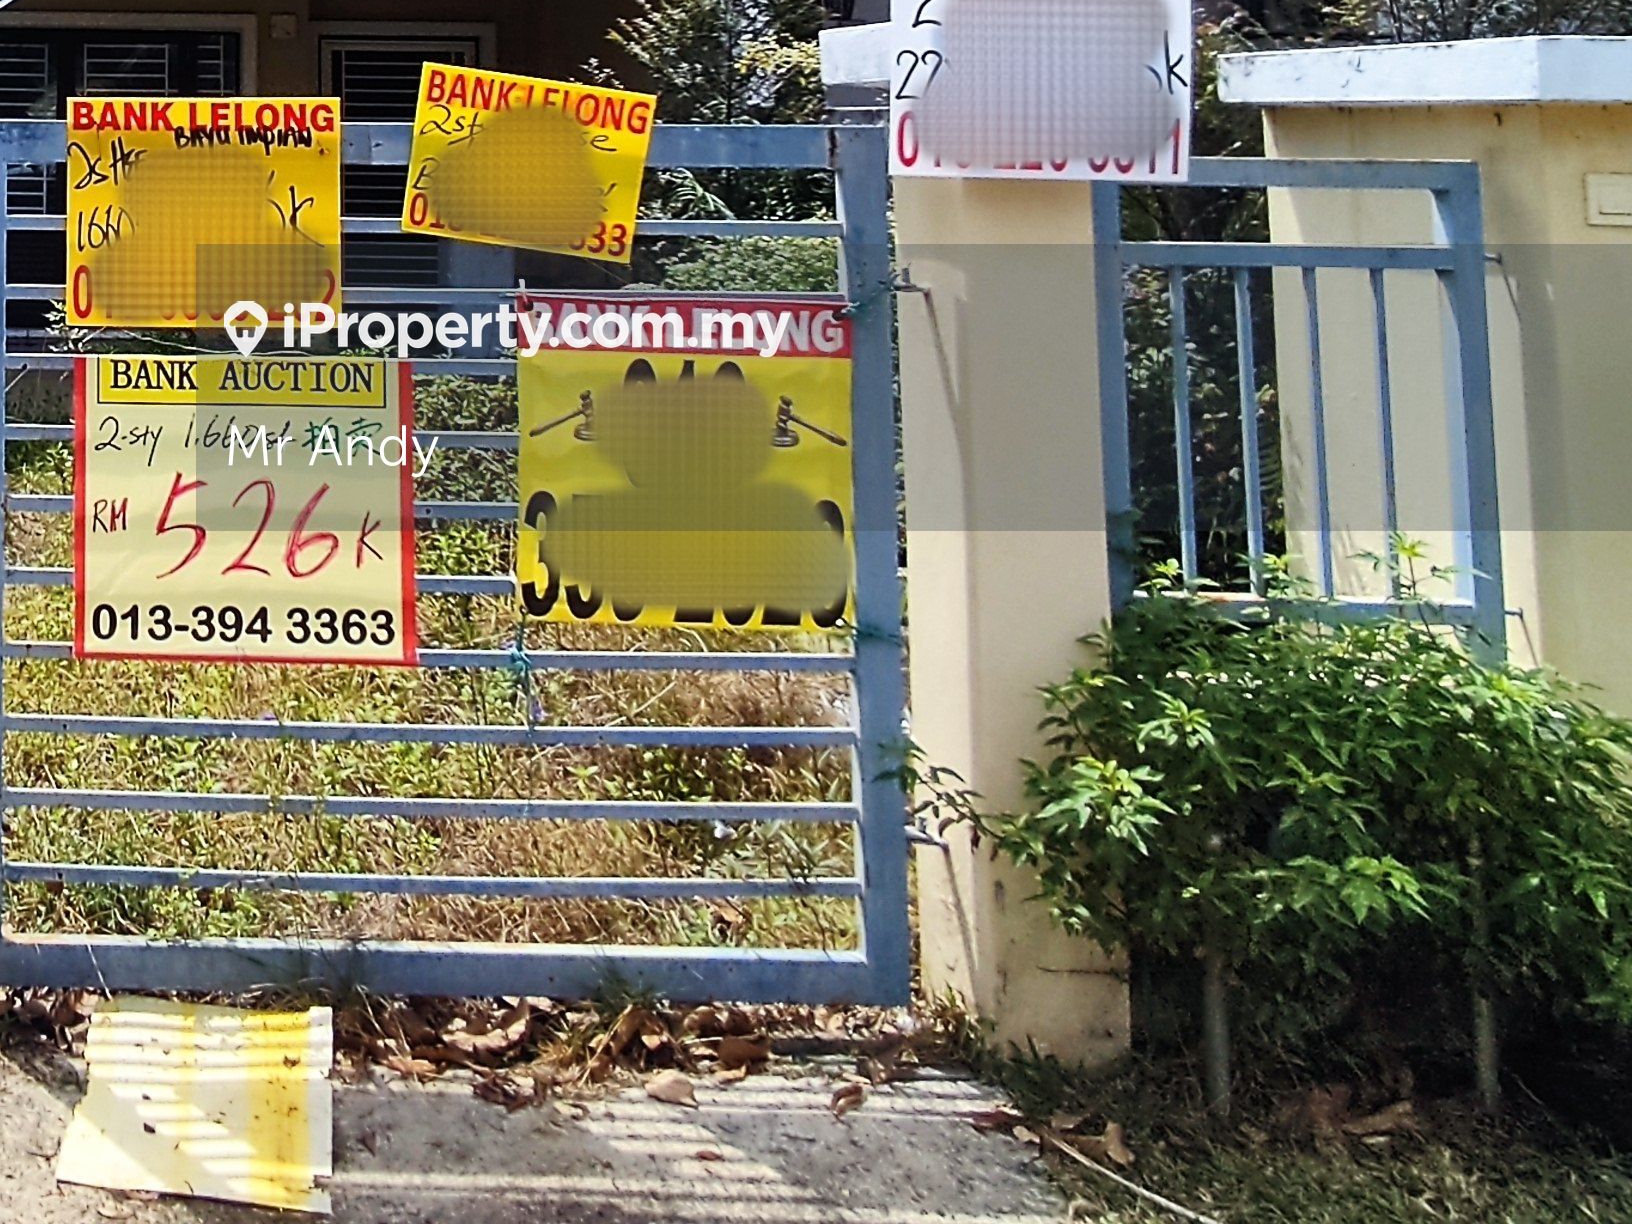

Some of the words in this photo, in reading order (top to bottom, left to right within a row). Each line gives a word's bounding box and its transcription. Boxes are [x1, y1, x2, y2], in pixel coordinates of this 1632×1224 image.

[426, 69, 518, 112] BANK
[72, 101, 176, 132] BANK
[188, 103, 335, 133] LELONG
[109, 360, 199, 391] BANK
[218, 362, 376, 394] AUCTION
[93, 497, 129, 534] RM
[155, 471, 340, 579] 526
[91, 603, 273, 643] 013-394
[285, 607, 396, 646] 3363
